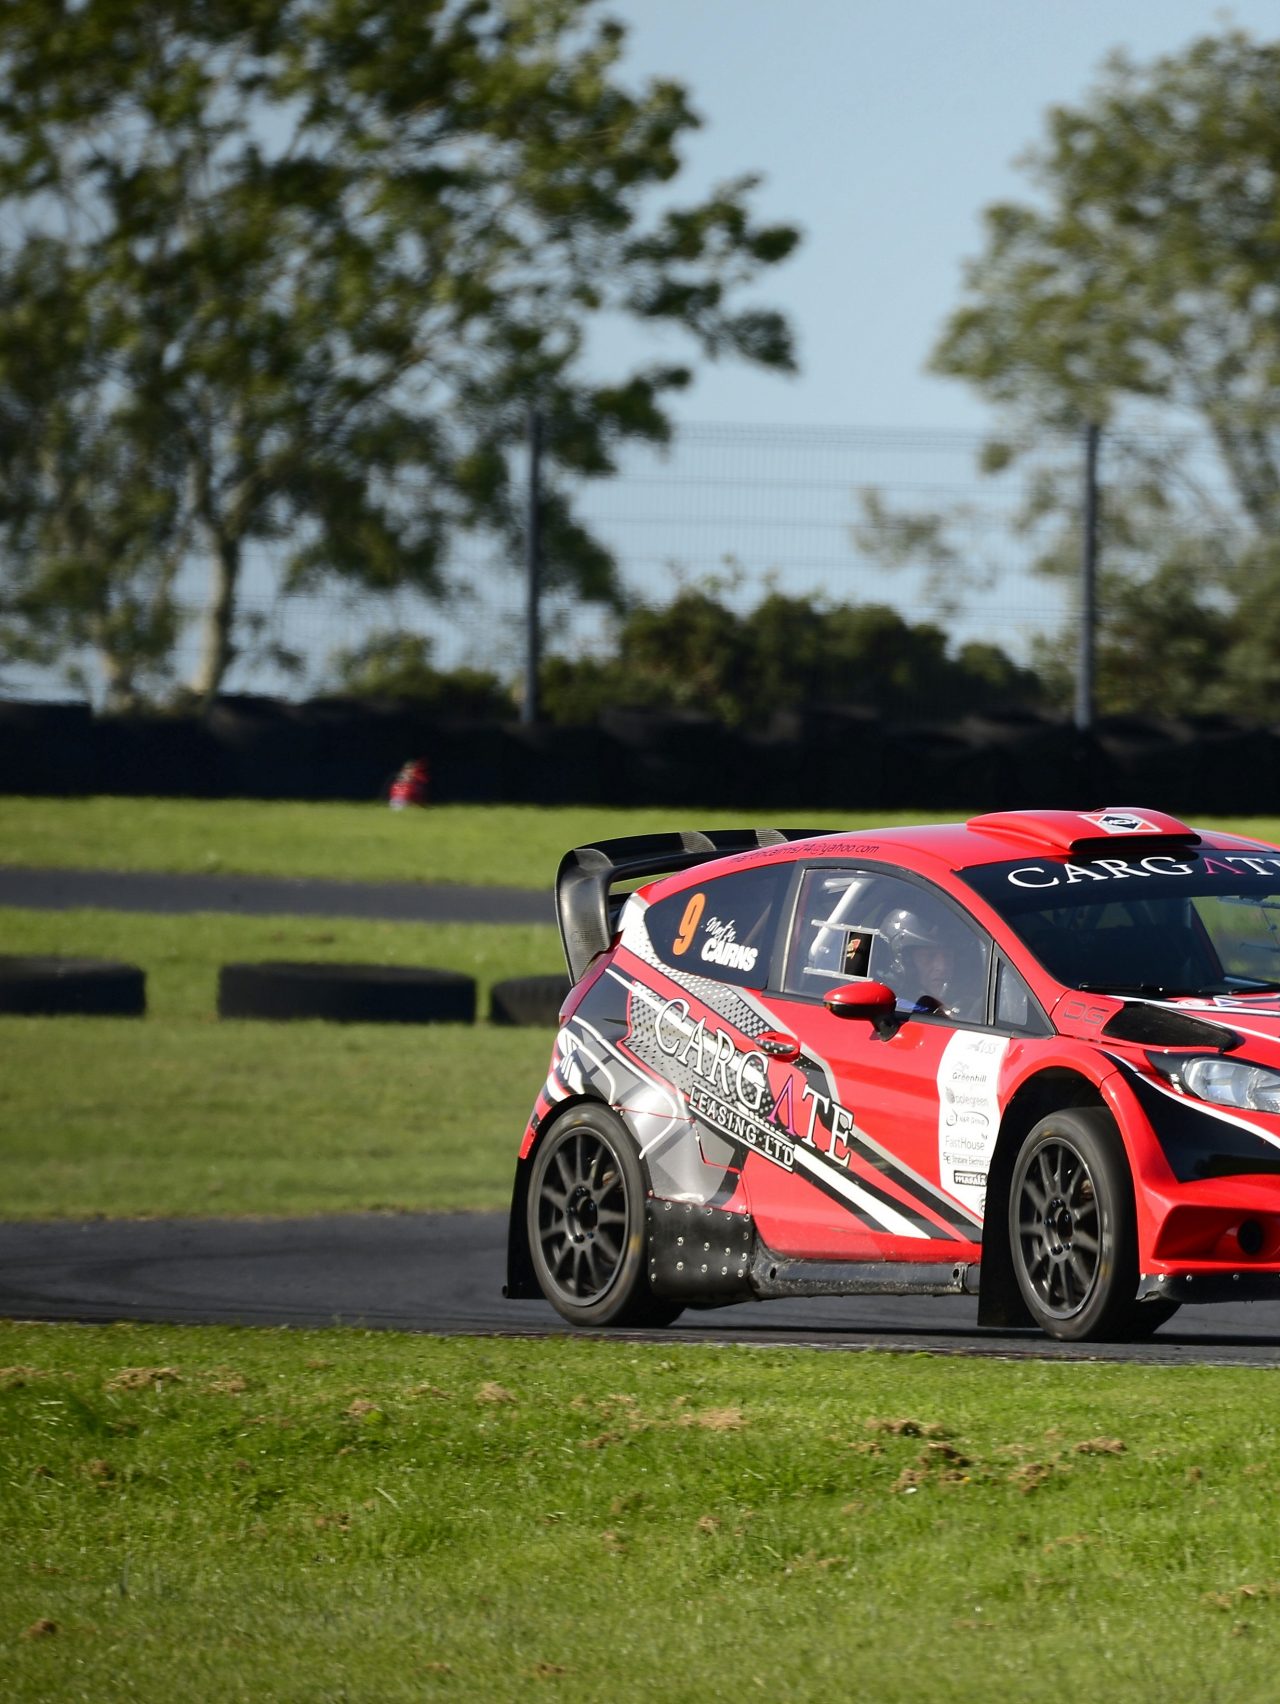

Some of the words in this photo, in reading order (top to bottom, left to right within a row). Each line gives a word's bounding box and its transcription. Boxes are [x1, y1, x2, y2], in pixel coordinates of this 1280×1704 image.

[671, 892, 708, 957] 9
[701, 937, 759, 972] CAIRNS
[653, 996, 856, 1169] CARGATE
[951, 1070, 987, 1084] Greenhill
[691, 1086, 760, 1146] LEASING
[763, 1136, 796, 1168] LTD
[945, 1135, 986, 1151] FastHouse
